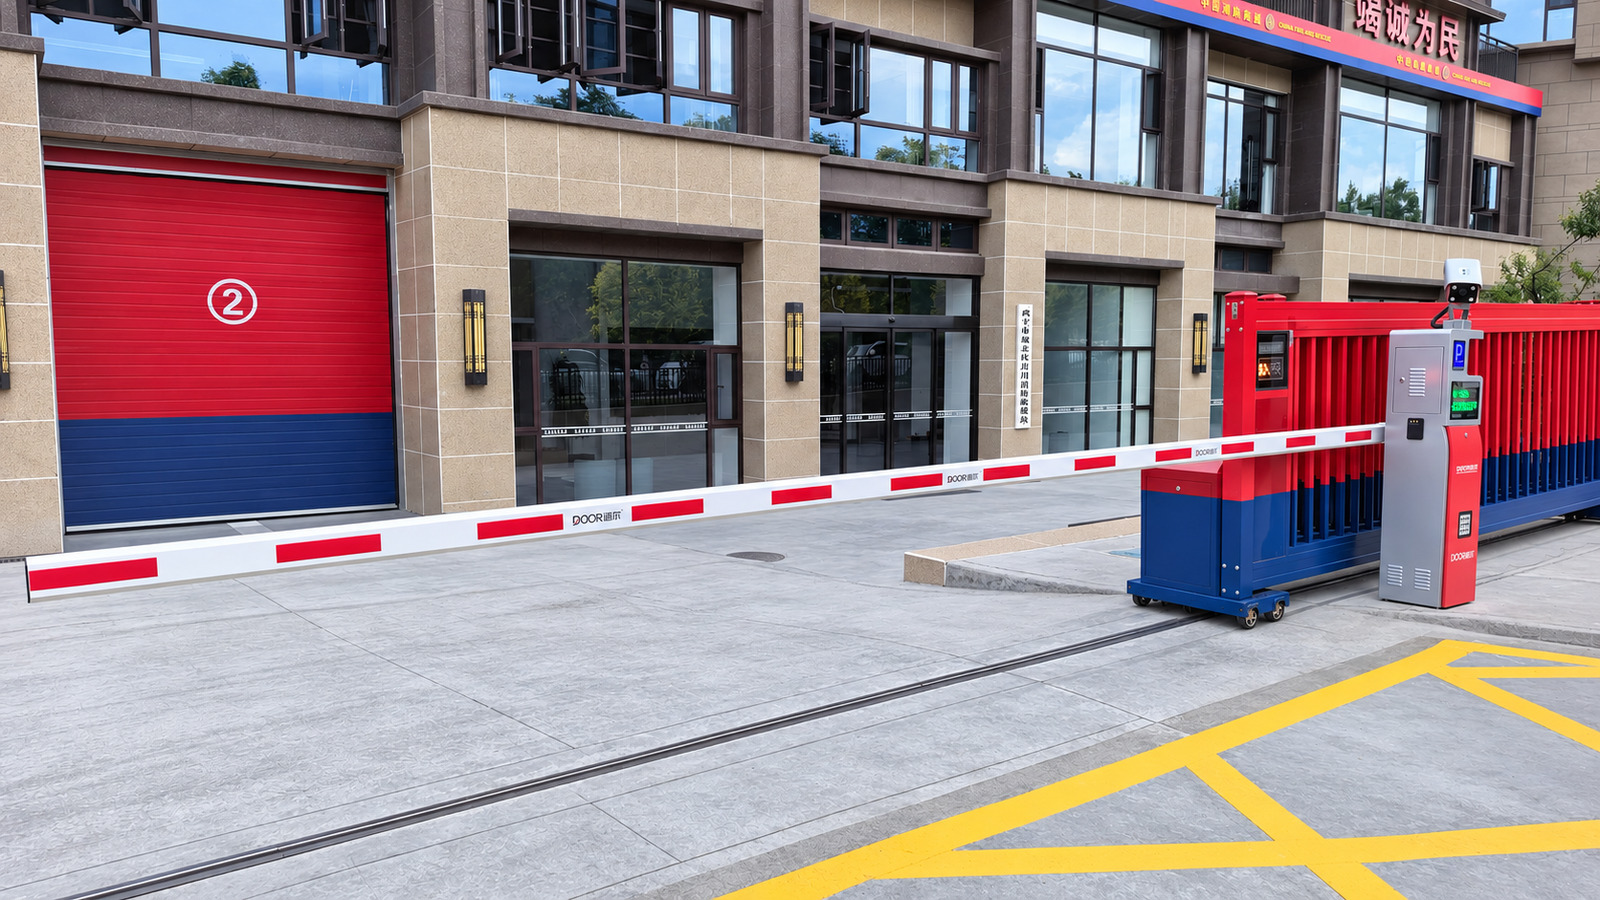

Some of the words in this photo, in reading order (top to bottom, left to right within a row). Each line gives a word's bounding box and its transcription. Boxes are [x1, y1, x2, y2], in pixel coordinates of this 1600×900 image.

[1355, 0, 1459, 62] 竭诚为民
[222, 288, 244, 316] 2
